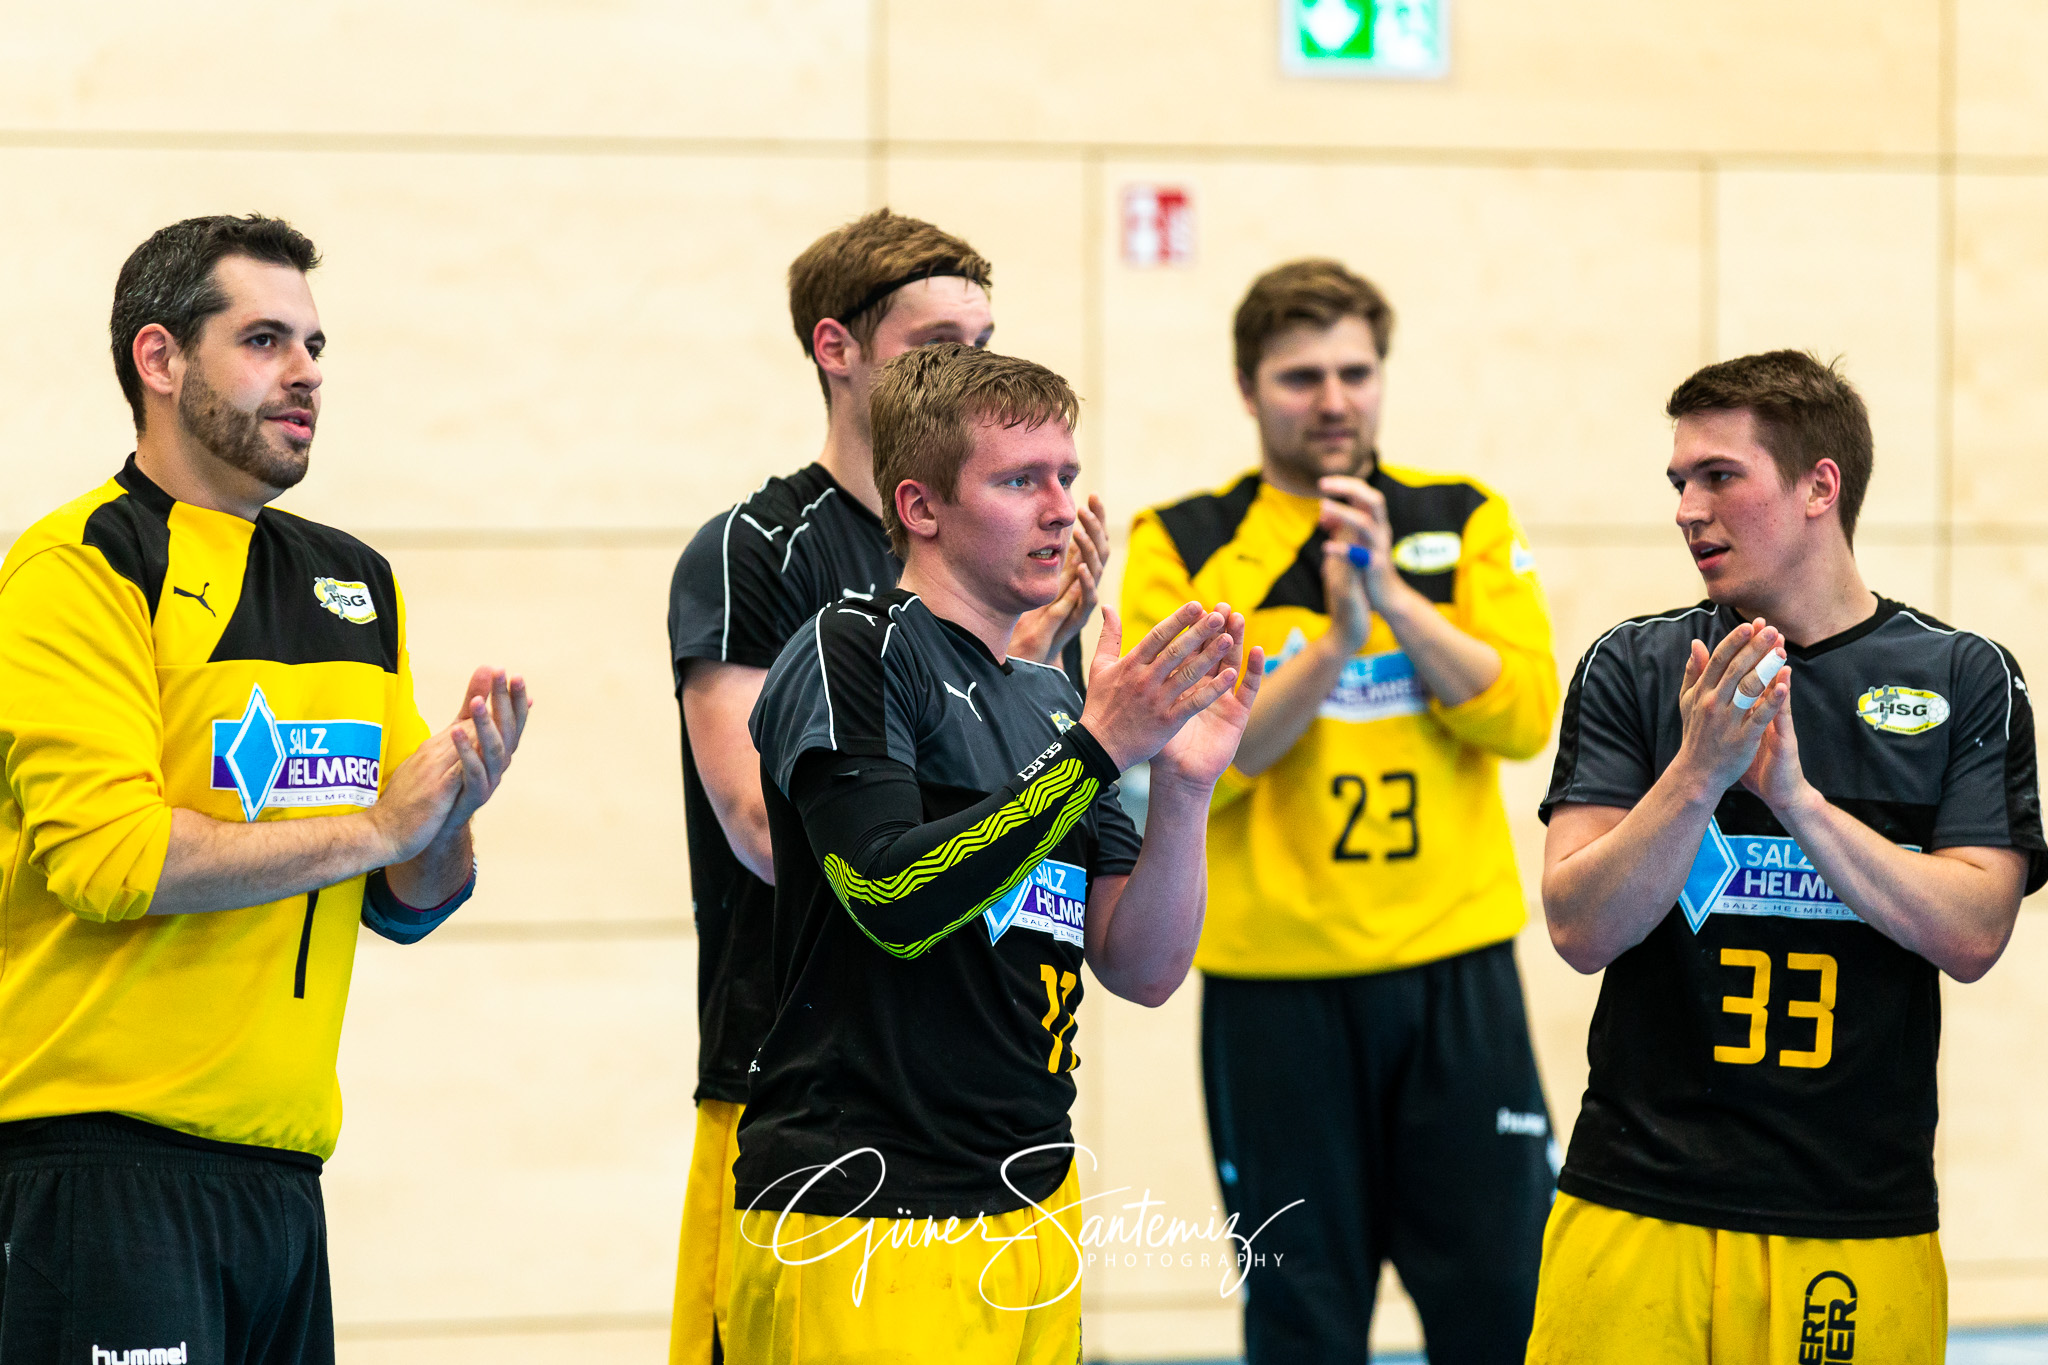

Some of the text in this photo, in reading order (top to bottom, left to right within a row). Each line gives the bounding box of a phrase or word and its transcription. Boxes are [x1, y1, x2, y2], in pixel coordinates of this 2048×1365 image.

[329, 592, 366, 607] HSG
[1879, 702, 1927, 717] HSG
[289, 727, 330, 755] SALZ
[1017, 741, 1063, 782] SELECT
[1331, 770, 1420, 864] 23
[1035, 862, 1067, 895] SALZ
[1021, 916, 1050, 928] SALZ
[1035, 886, 1086, 929] HELMR
[1722, 901, 1759, 911] SALZ
[1040, 963, 1078, 1074] 11
[1713, 947, 1839, 1070] 33
[1824, 1297, 1858, 1365] ER
[91, 1341, 188, 1365] hummel
